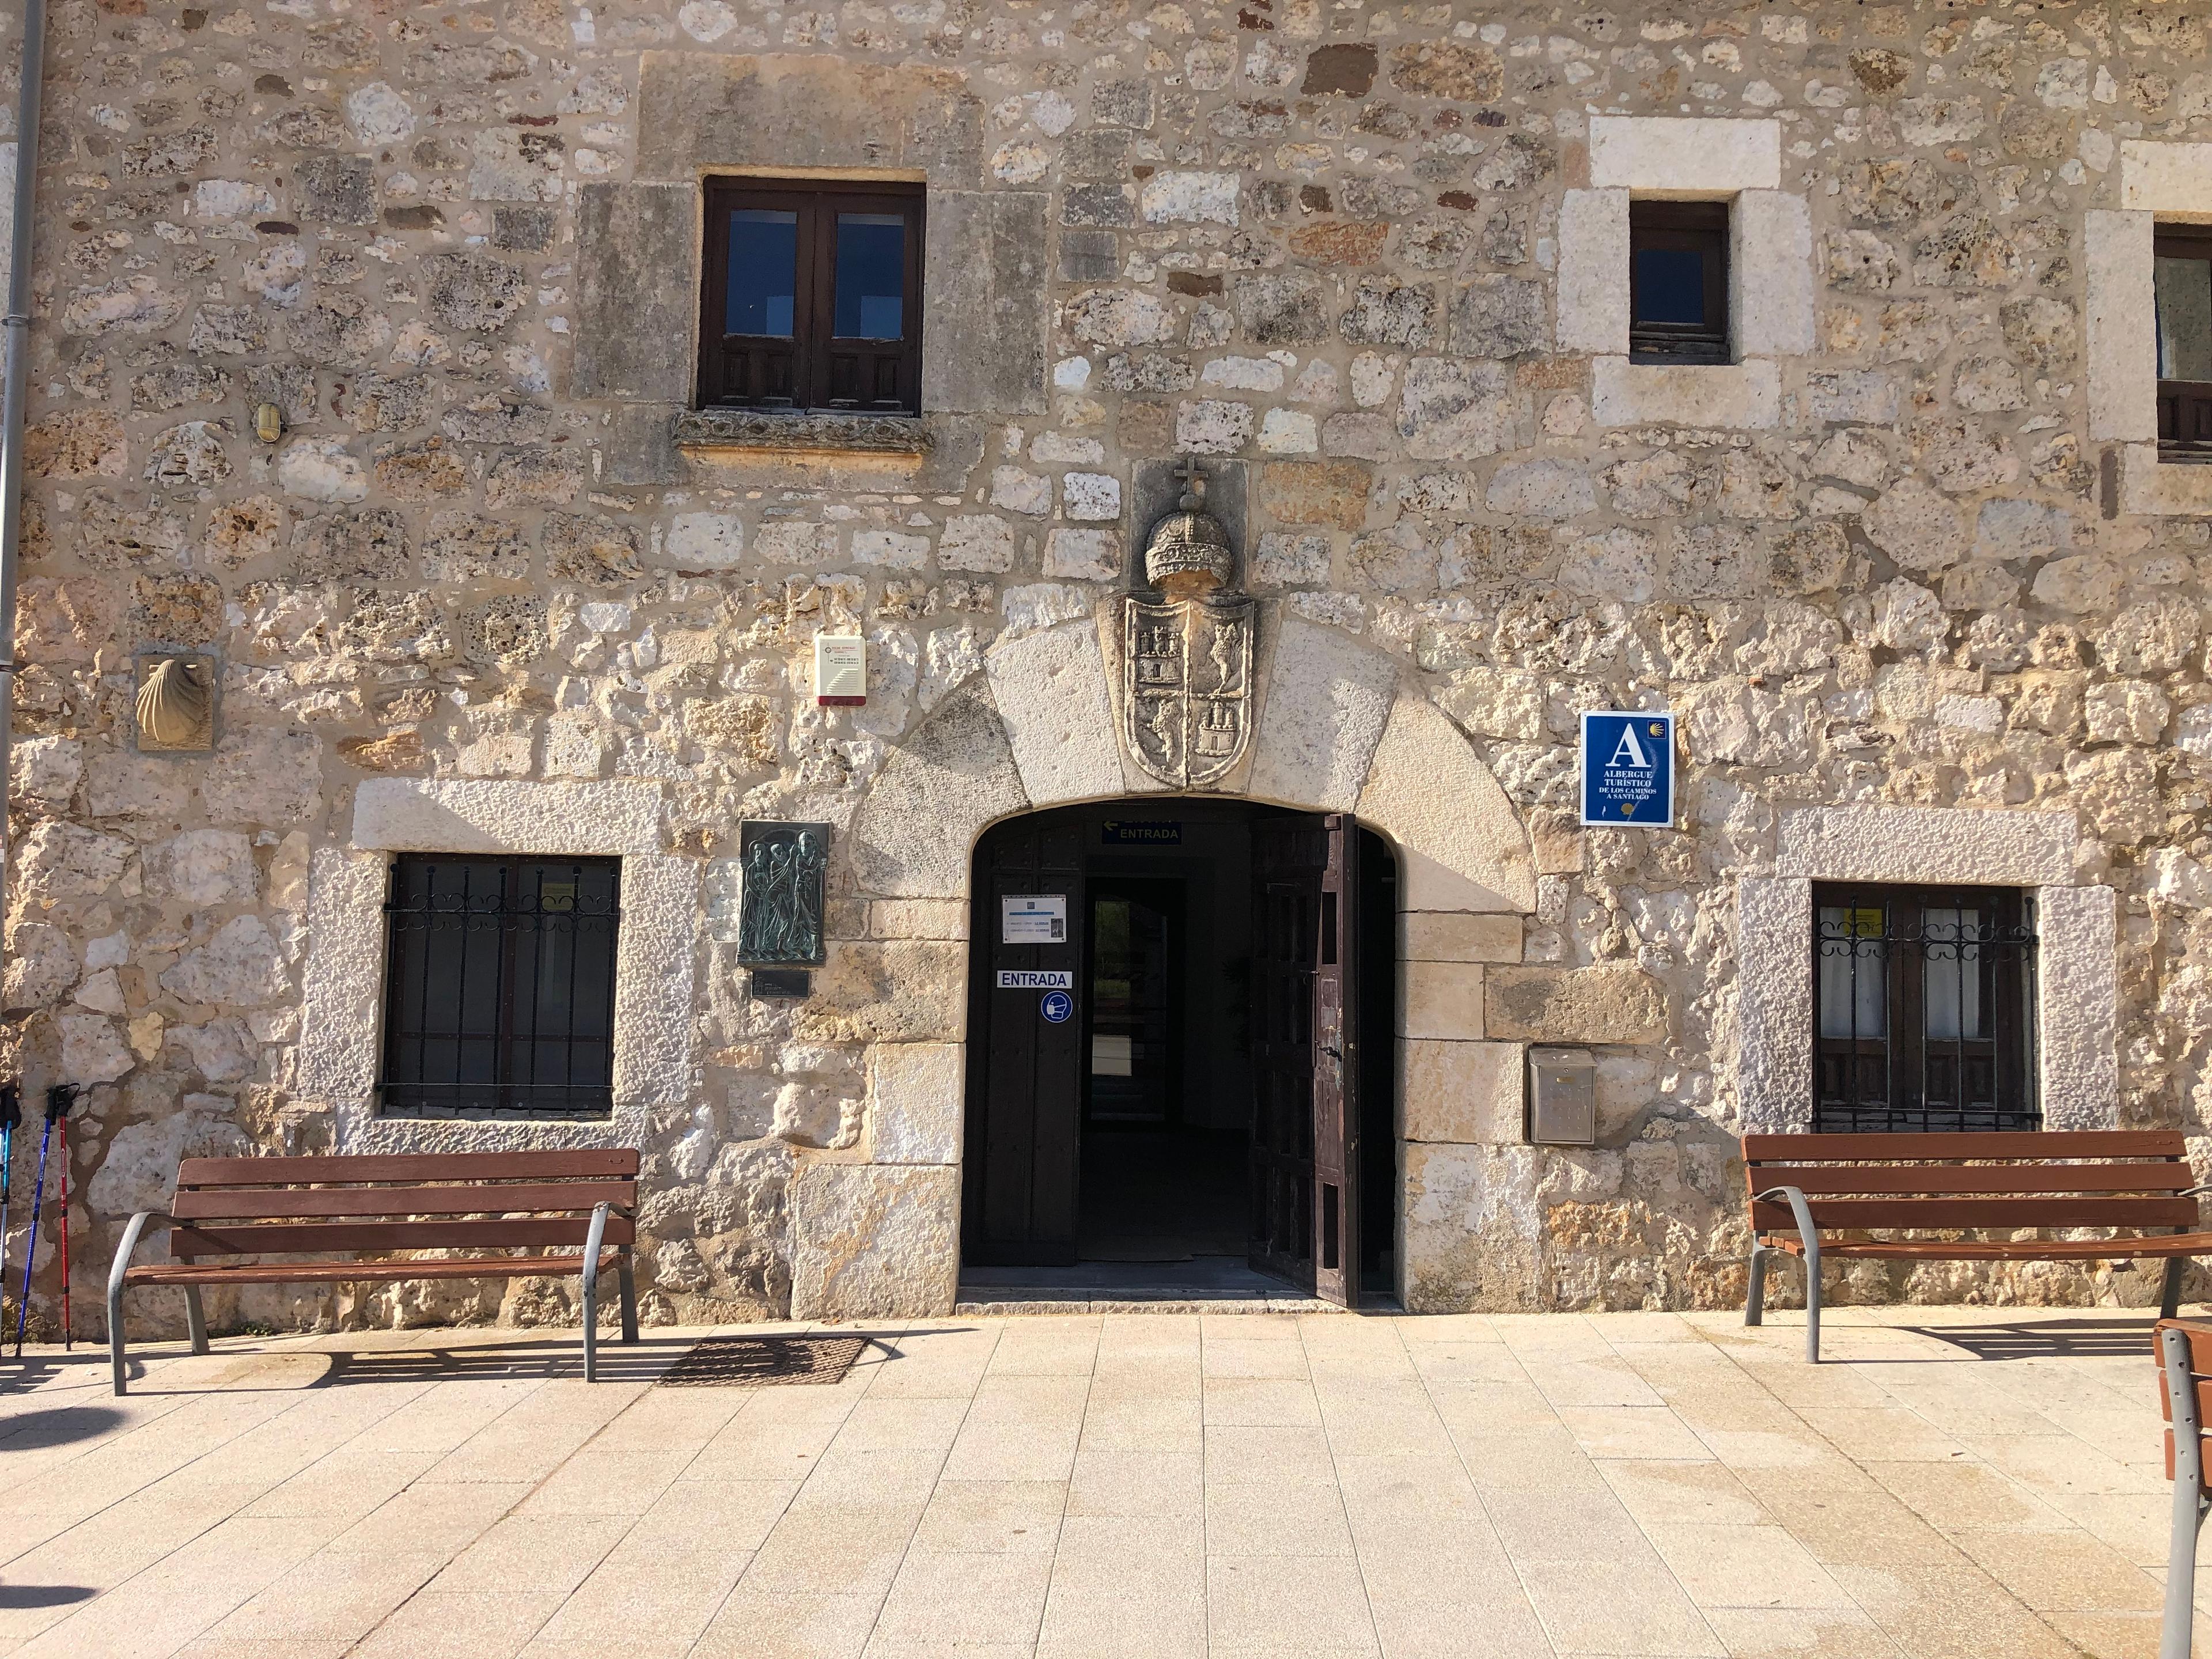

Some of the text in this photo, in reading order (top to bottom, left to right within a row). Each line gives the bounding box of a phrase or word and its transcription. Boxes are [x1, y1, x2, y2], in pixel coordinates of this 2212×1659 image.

[1605, 723, 1652, 767] A
[1604, 770, 1653, 779] ALBERGUE
[1604, 777, 1652, 787] TURÍSTICO
[1120, 829, 1179, 839] ENTRADA
[1002, 972, 1067, 986] ENTRADA
